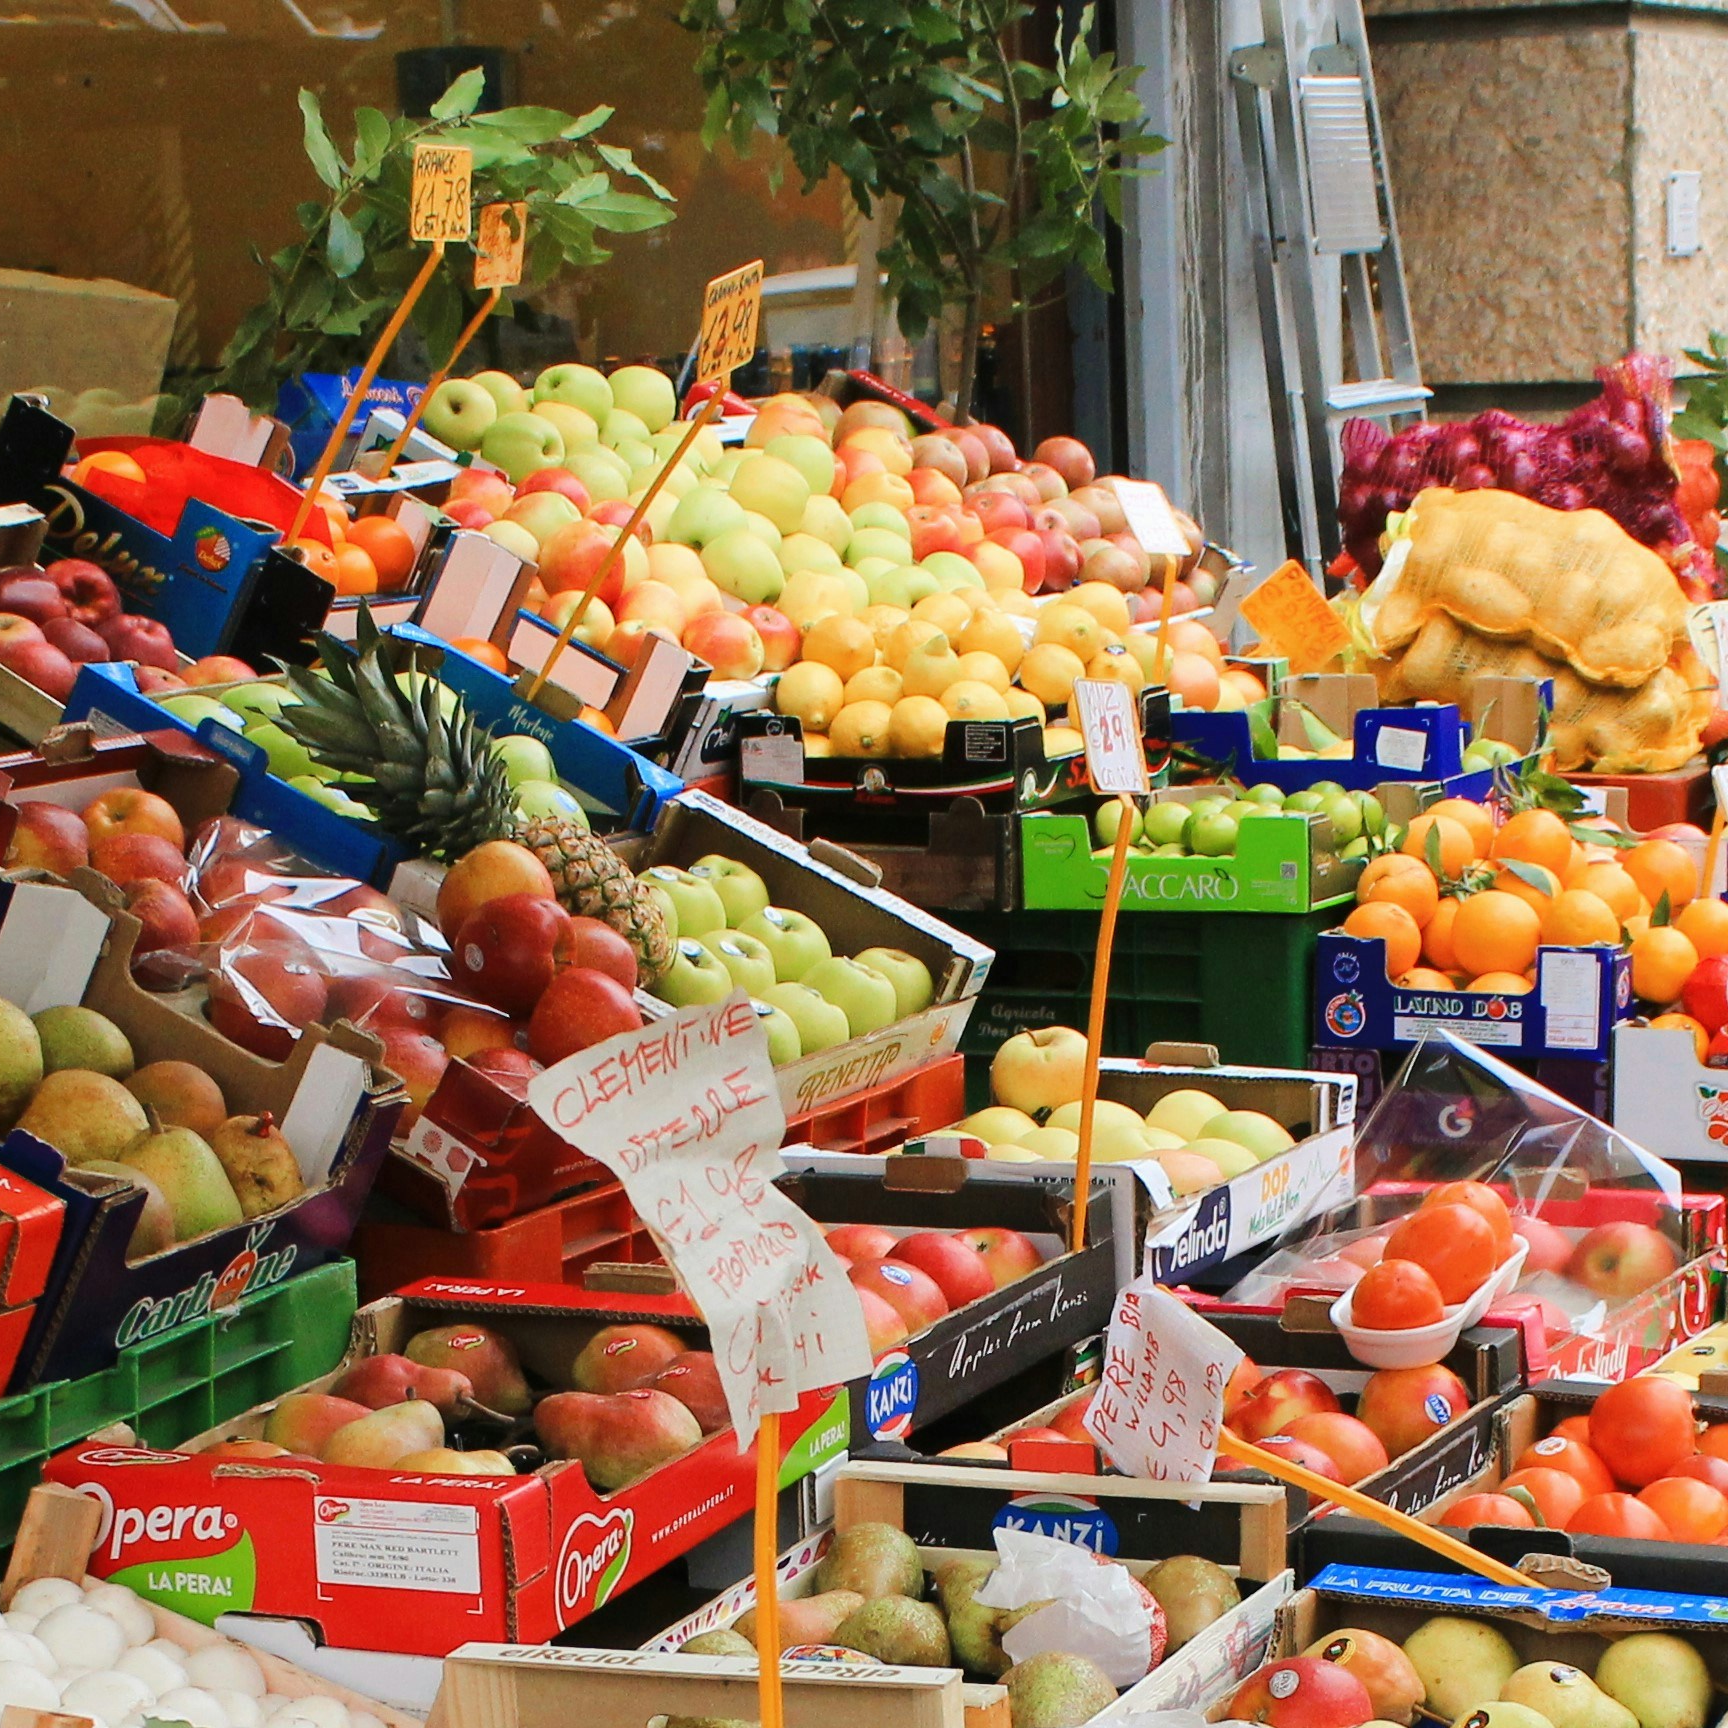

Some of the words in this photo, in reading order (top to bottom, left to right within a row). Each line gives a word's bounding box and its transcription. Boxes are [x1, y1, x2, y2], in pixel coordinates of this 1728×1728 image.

[1393, 995, 1465, 1016] LATINO
[552, 1002, 755, 1130] CLEMENTINE
[1260, 1162, 1291, 1200] DOP
[949, 1334, 1002, 1379] Apples
[1007, 1310, 1043, 1348] from
[1050, 1274, 1089, 1322] Kanzi
[1092, 1345, 1136, 1446] PERE
[808, 1437, 824, 1458] LA
[823, 1423, 847, 1454] PERA!
[389, 1475, 422, 1486] LA
[423, 1476, 508, 1491] PERA!
[319, 1502, 349, 1518] Opera
[649, 1484, 736, 1545] WWW.OPERALAPERA.IT
[331, 1541, 358, 1550] PERE
[359, 1543, 383, 1551] MAX
[384, 1545, 407, 1553] RED
[407, 1546, 460, 1557] BARTLETT
[147, 1571, 170, 1592] LA
[175, 1572, 233, 1597] PERA!
[367, 1561, 413, 1572] ORIGINE:
[415, 1565, 450, 1574] ITALIA
[561, 1526, 622, 1611] Opera
[1322, 1574, 1360, 1590] LA
[1363, 1577, 1475, 1601] FRUTTA
[1476, 1587, 1537, 1607] DEL
